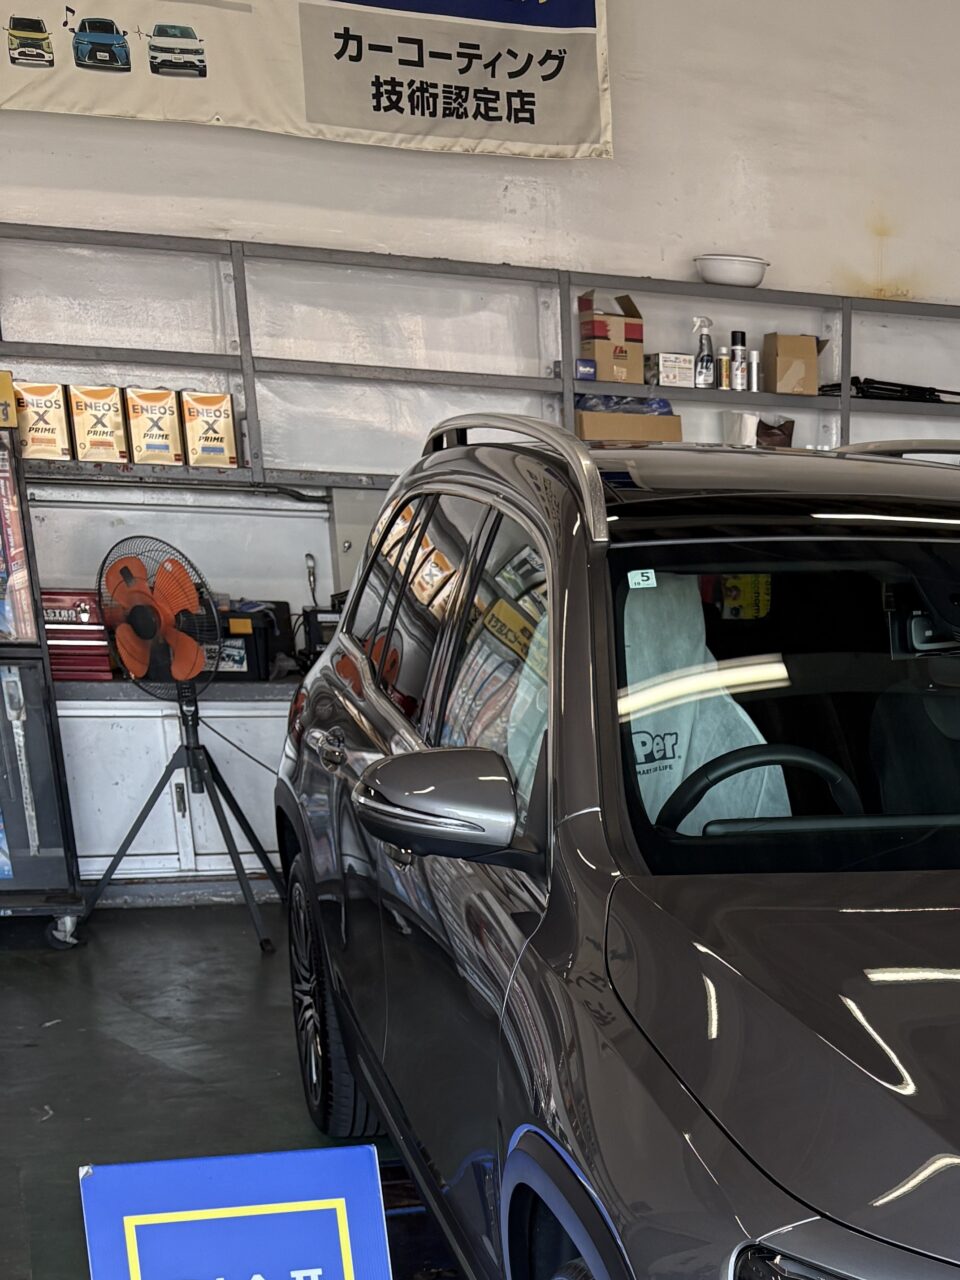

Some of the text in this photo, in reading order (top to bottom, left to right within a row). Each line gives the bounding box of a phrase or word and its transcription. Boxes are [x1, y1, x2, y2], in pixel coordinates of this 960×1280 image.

[333, 26, 568, 83] カーコーティング
[371, 75, 537, 125] 技術認定店
[17, 397, 62, 410] ENEOS
[75, 401, 120, 413] ENEOS
[132, 404, 175, 416] ENEOS
[31, 410, 51, 426] X
[188, 407, 230, 419] ENEOS
[90, 413, 108, 429] X
[146, 416, 165, 432] X
[201, 419, 220, 435] X
[143, 432, 170, 440] PRIME
[199, 435, 225, 443] PRIME
[641, 572, 650, 582] 5
